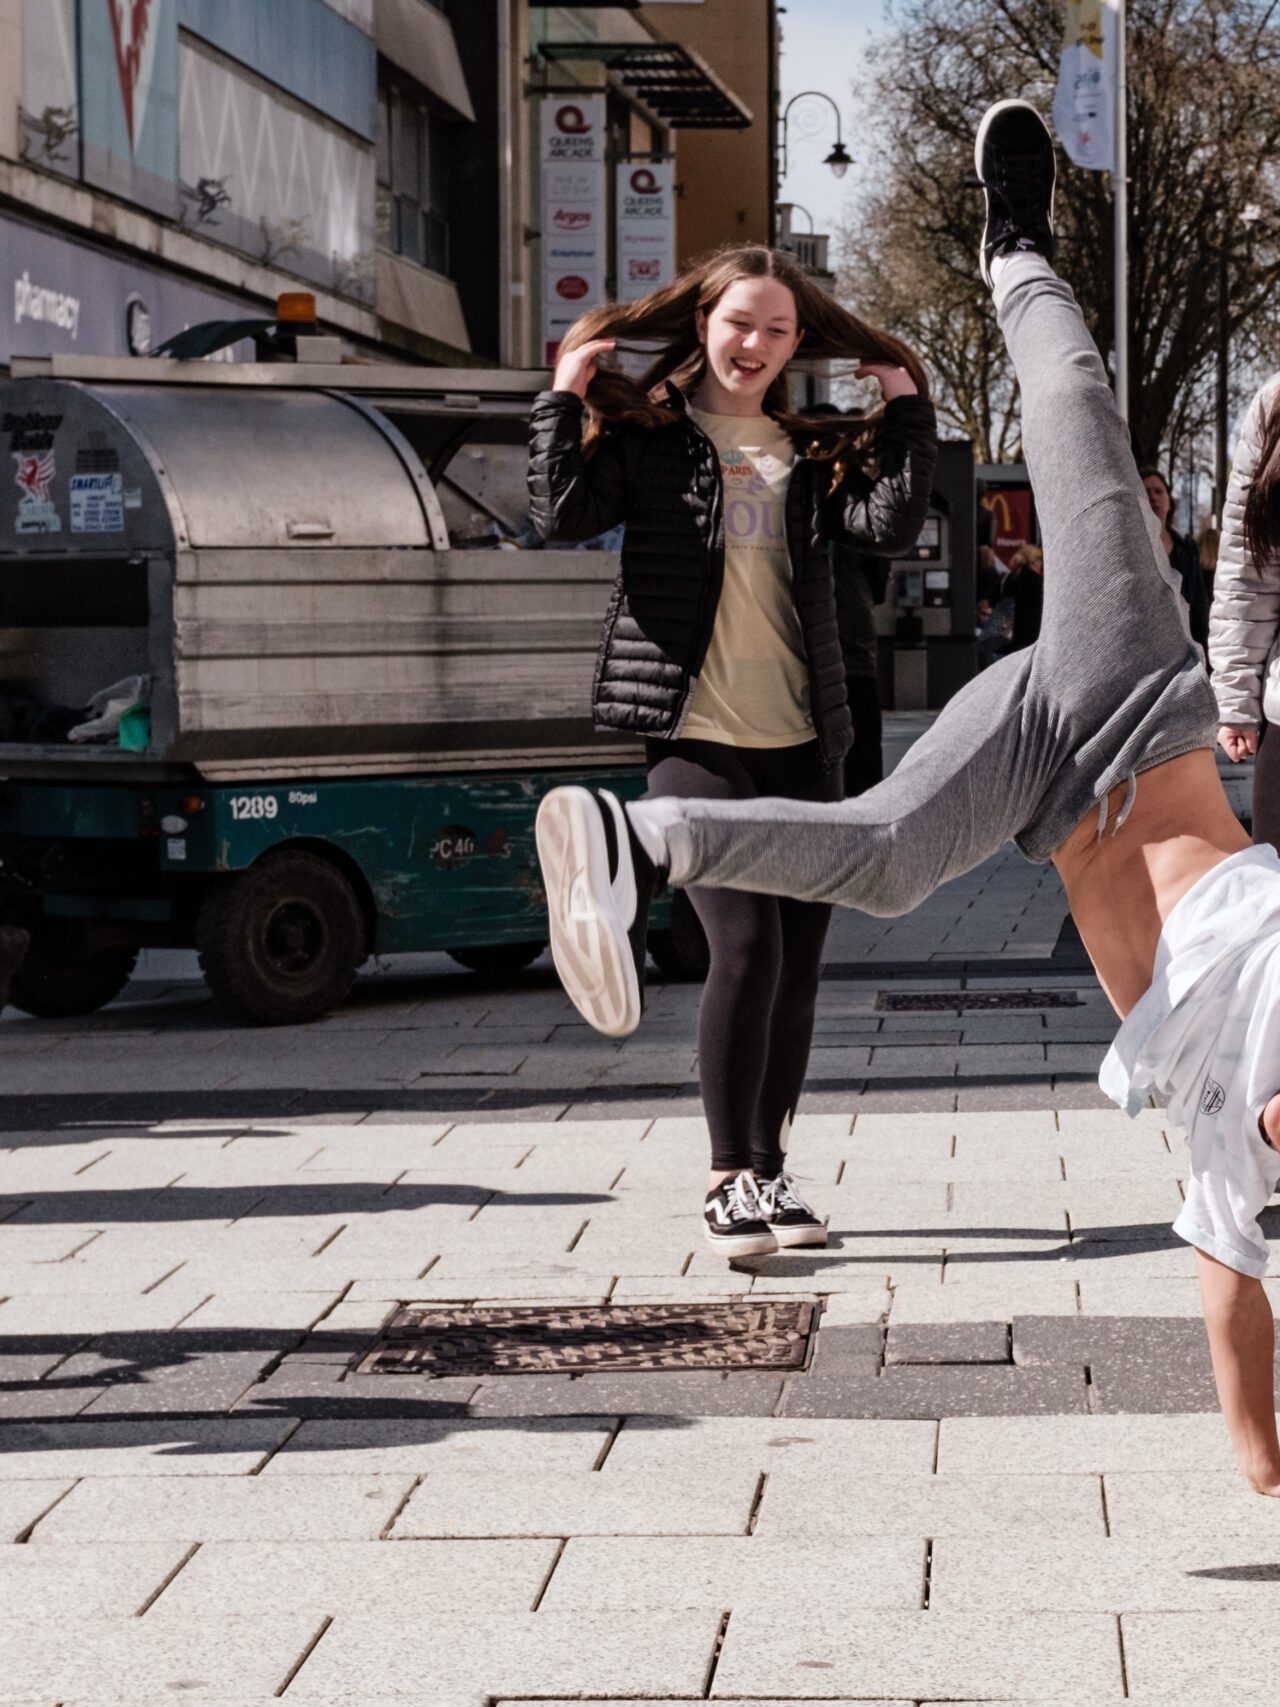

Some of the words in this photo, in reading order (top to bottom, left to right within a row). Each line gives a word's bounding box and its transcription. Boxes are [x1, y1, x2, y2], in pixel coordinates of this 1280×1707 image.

[549, 137, 594, 147] QUEENS
[550, 148, 593, 158] ARCADE
[623, 197, 664, 206] QUEENS
[553, 208, 592, 225] Argos
[623, 207, 663, 216] ARCADE
[14, 271, 80, 339] pharmacy
[720, 466, 753, 475] PARIS
[230, 796, 279, 820] 1289
[288, 791, 318, 806] 80psi
